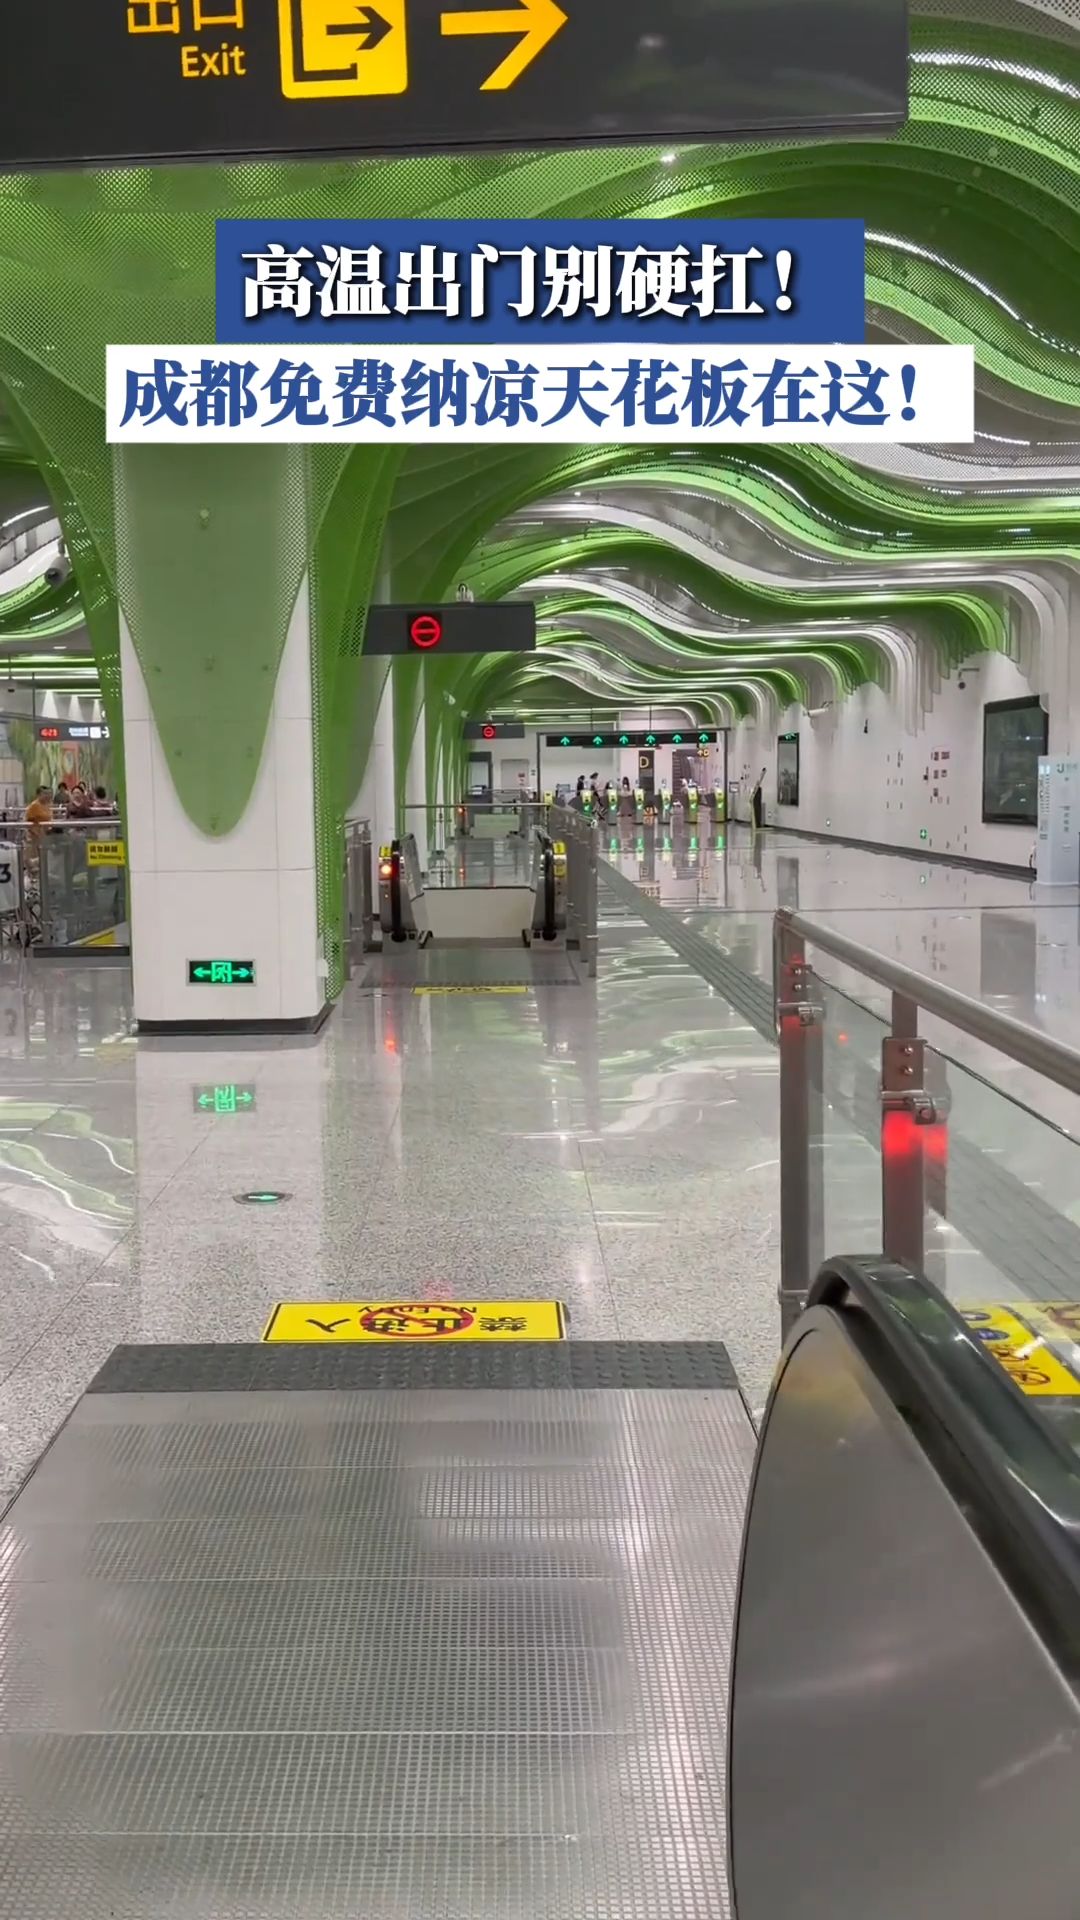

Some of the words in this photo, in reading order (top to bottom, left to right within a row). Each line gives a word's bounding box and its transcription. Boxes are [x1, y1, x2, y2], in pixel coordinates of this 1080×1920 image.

[127, 0, 244, 34] 出口
[181, 42, 247, 78] Exit
[639, 756, 649, 768] D
[357, 1306, 429, 1315] Entry
[443, 1306, 478, 1314] No
[305, 1316, 527, 1334] 禁止进入
